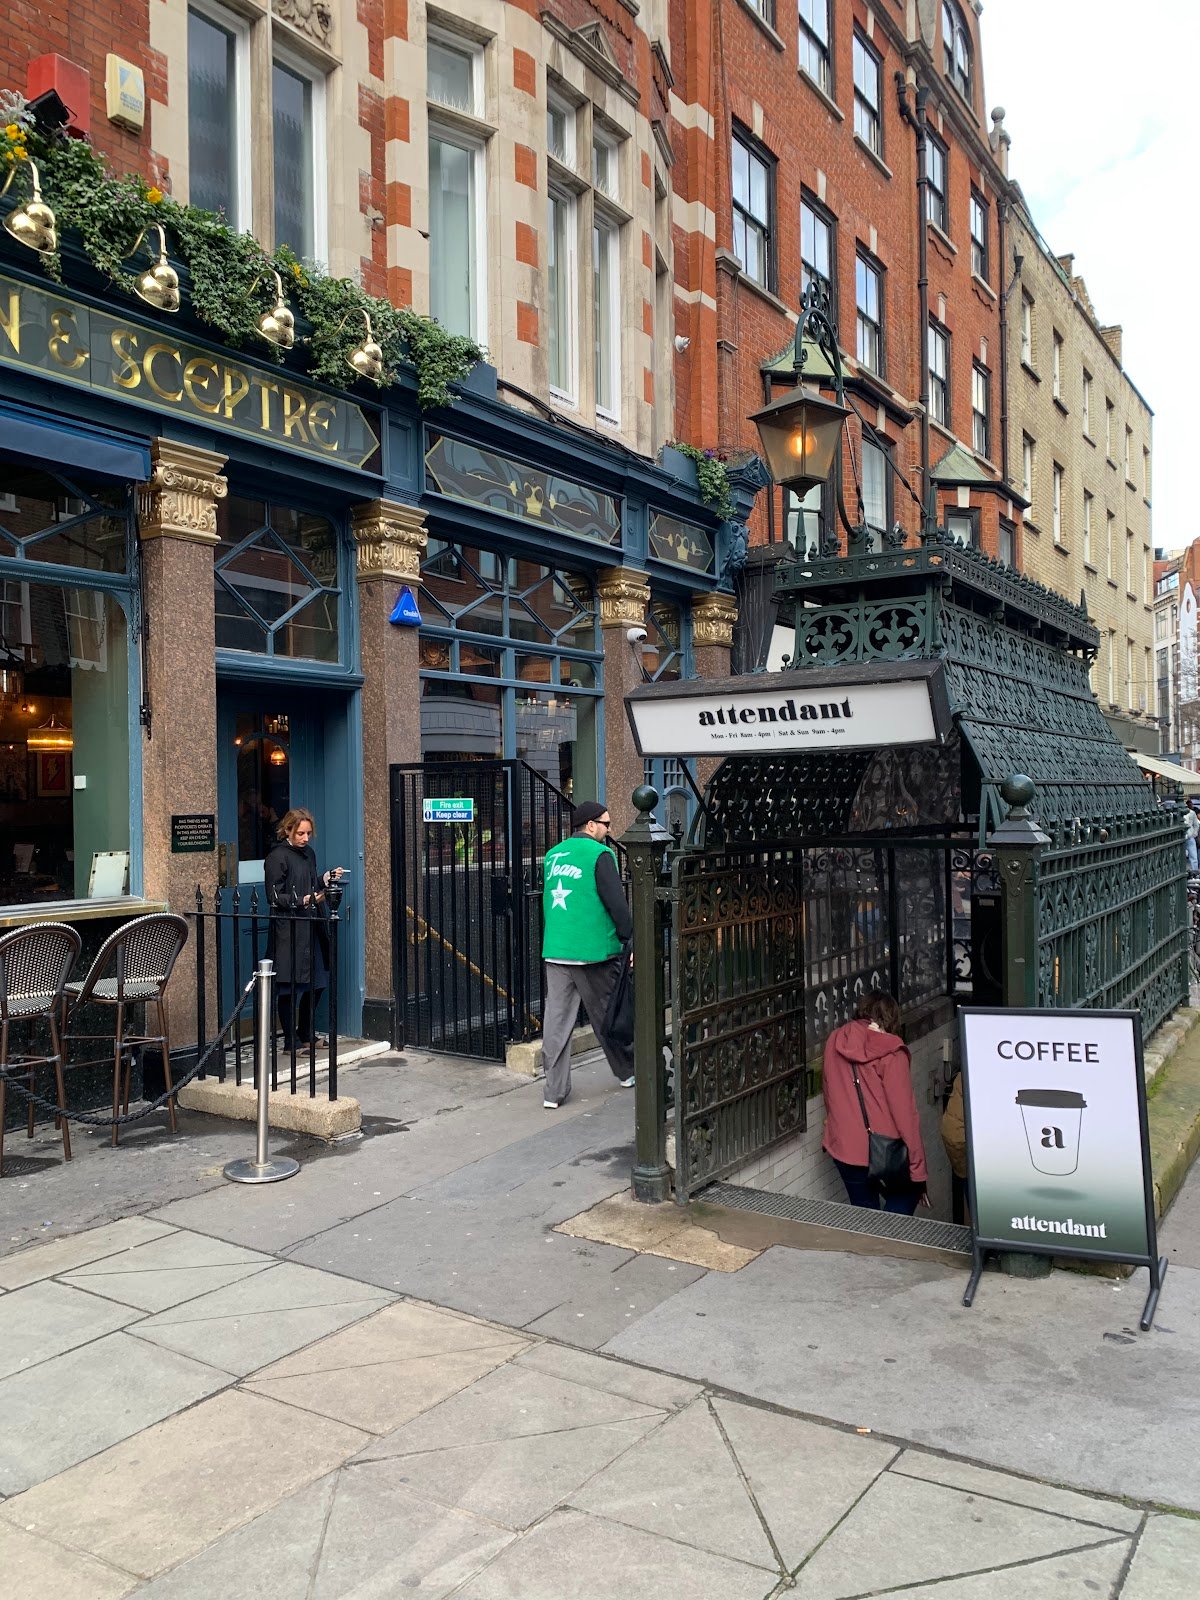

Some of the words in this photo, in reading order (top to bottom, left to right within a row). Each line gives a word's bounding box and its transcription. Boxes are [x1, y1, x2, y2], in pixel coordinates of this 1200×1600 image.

[110, 328, 339, 451] SCEPTRE
[402, 609, 419, 618] Chubb
[698, 696, 854, 726] attendant
[758, 731, 771, 739] 4pm
[830, 727, 845, 735] 4pm
[435, 811, 452, 819] Keep
[452, 811, 468, 819] clear
[439, 801, 452, 809] Fire
[452, 801, 464, 809] exit
[546, 851, 583, 880] Team
[997, 1040, 1100, 1063] COFFEE
[1040, 1125, 1067, 1149] a
[1010, 1214, 1108, 1239] attendant
